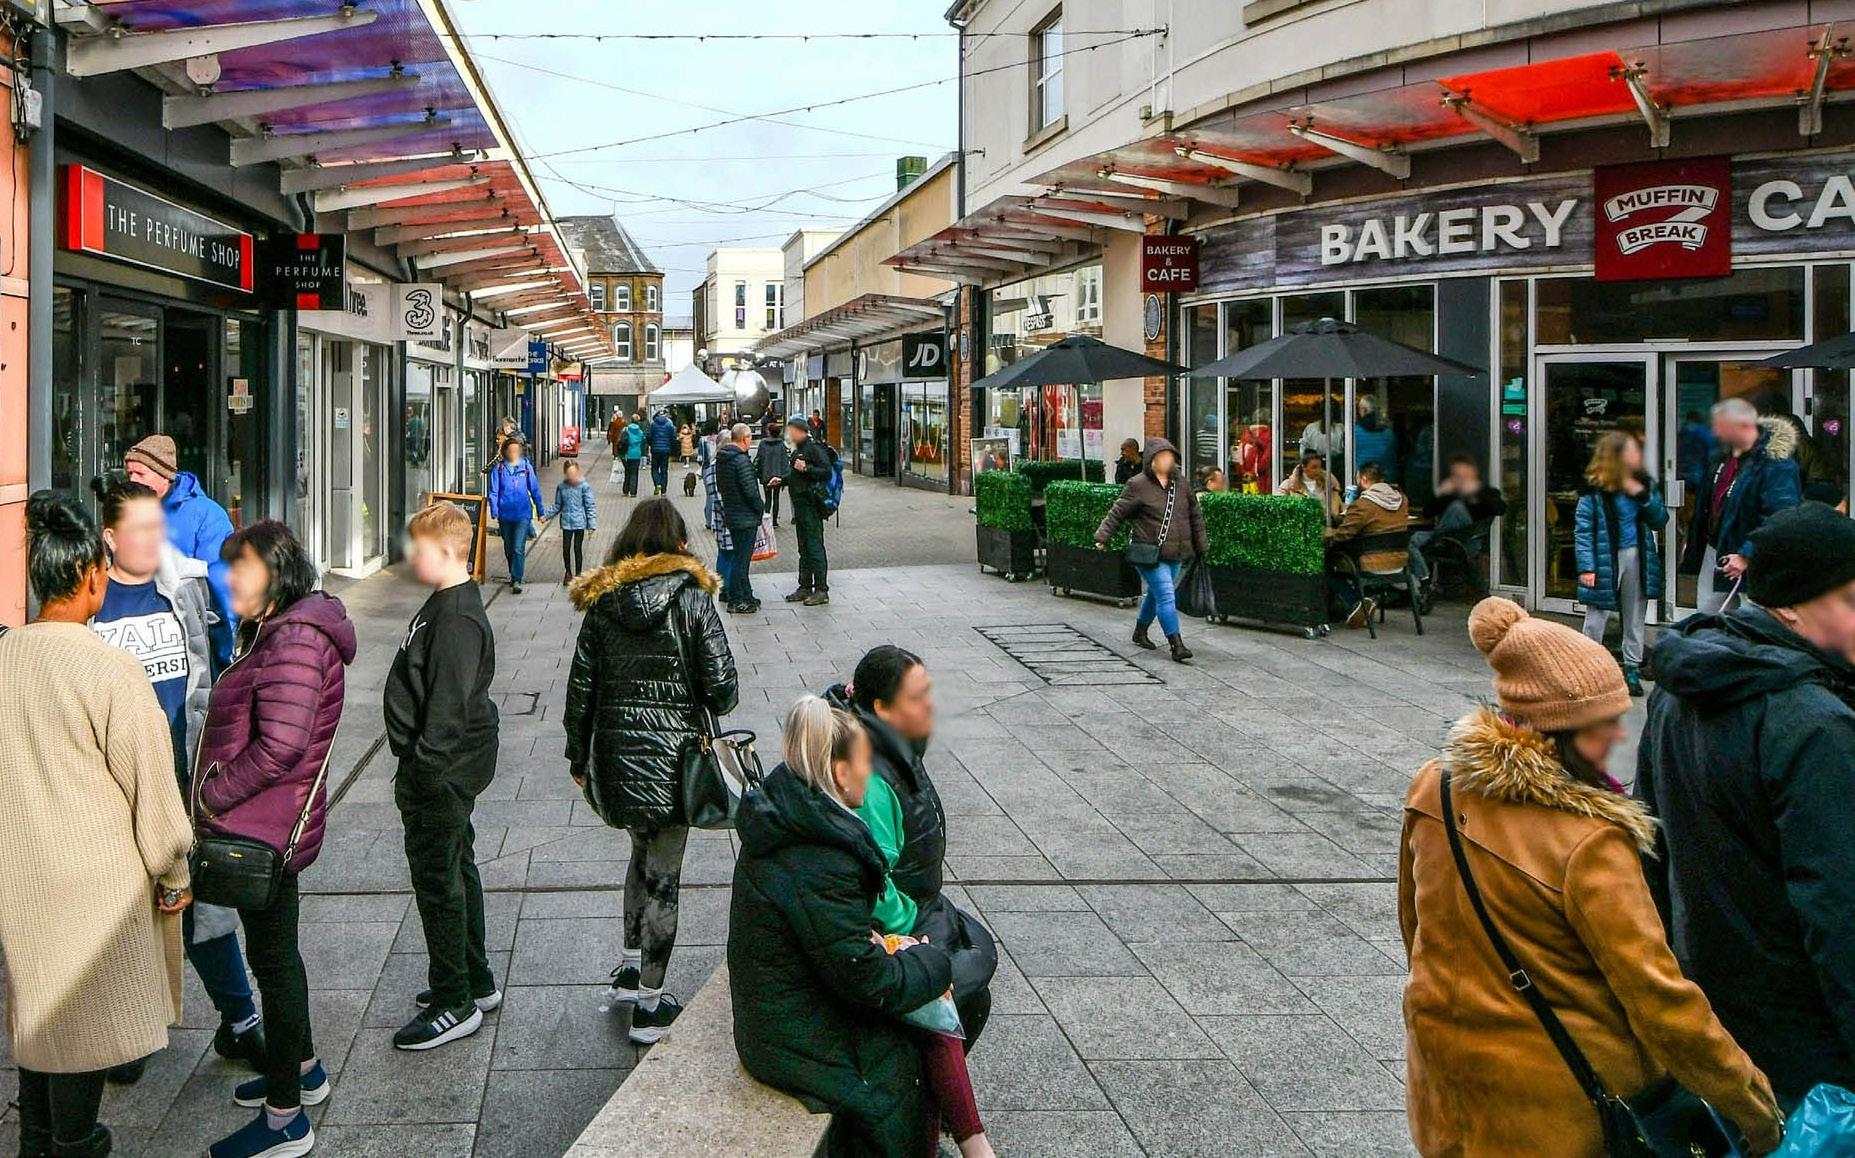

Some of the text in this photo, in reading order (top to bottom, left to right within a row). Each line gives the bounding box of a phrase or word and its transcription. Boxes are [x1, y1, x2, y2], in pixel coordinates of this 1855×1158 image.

[1617, 189, 1706, 212] MUFFIN
[1748, 175, 1855, 231] CA
[107, 204, 240, 269] THE PERFUME SHOP
[1321, 199, 1578, 266] BAKERY
[1625, 225, 1698, 244] BREAK
[1147, 246, 1191, 255] BAKERY
[1165, 257, 1173, 266] &
[276, 266, 341, 277] PERFUME
[1147, 268, 1191, 281] CAFE
[295, 281, 321, 289] SHOP
[346, 282, 368, 317] hree.
[405, 289, 435, 329] 3
[909, 343, 940, 367] JD
